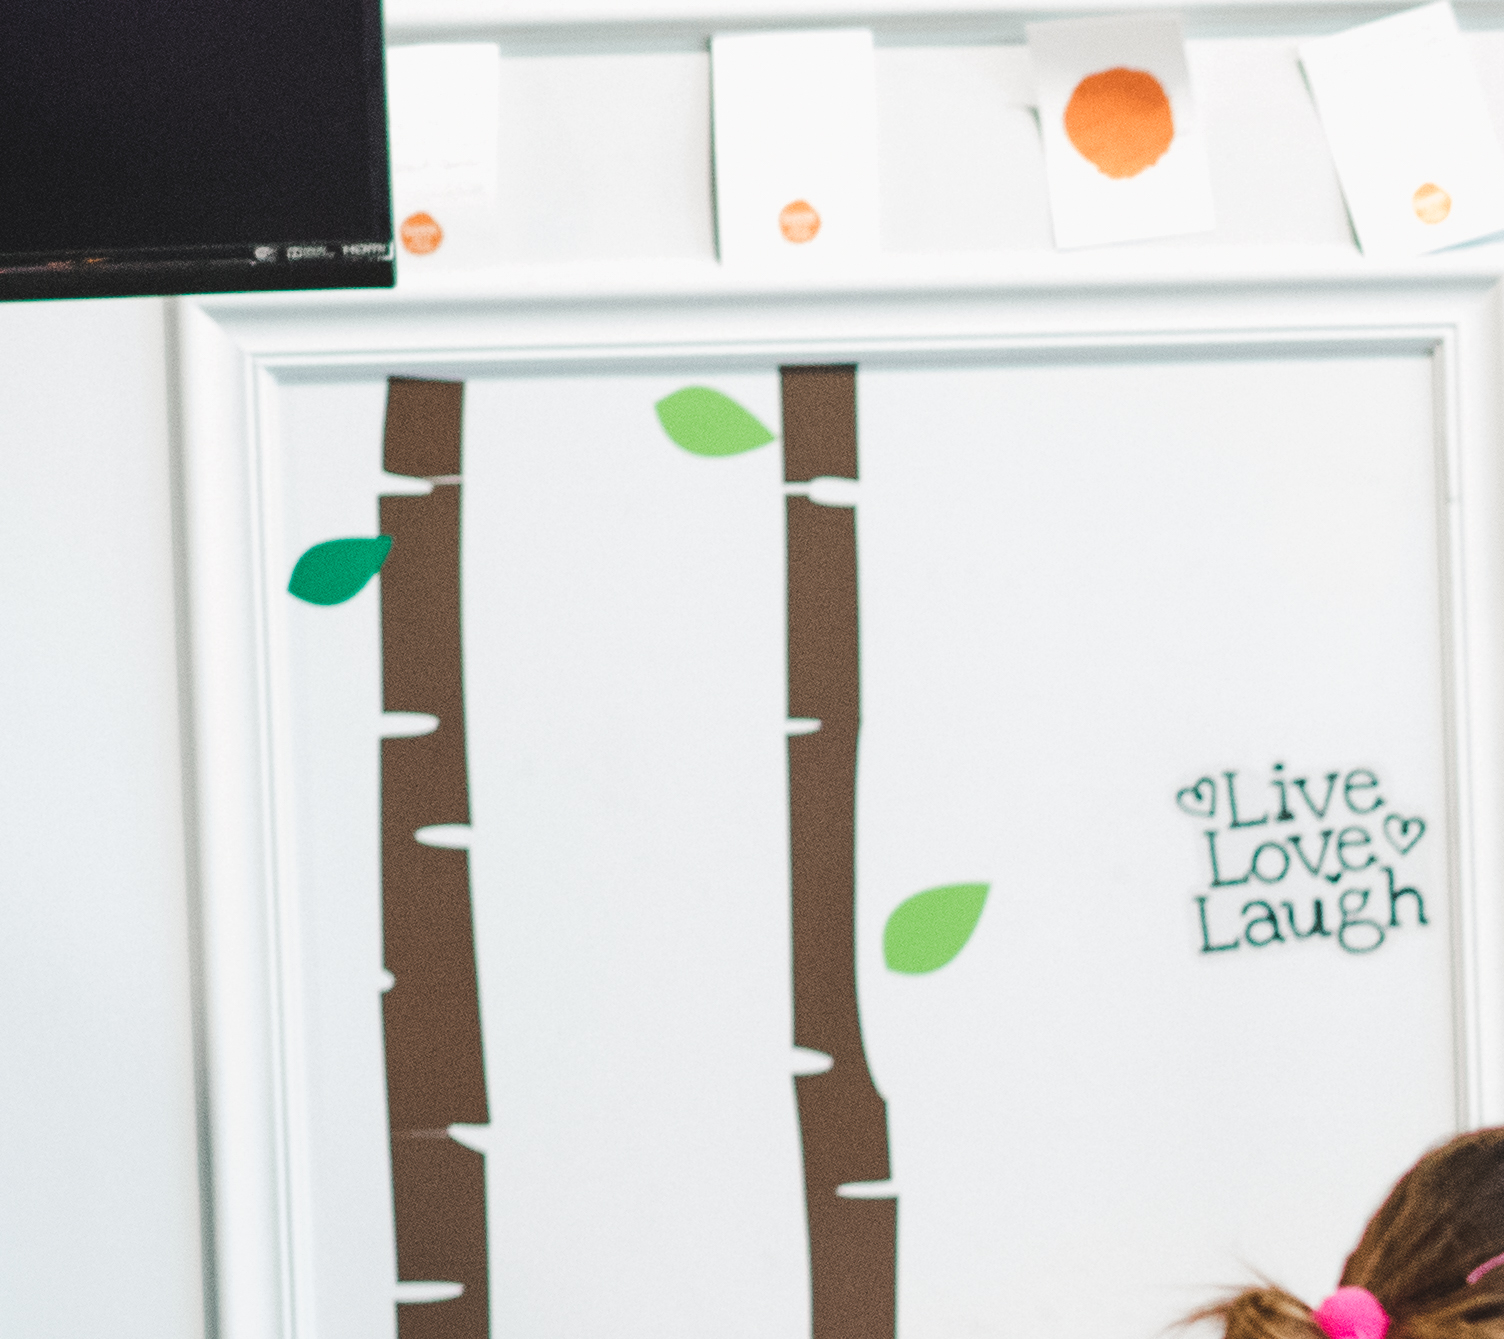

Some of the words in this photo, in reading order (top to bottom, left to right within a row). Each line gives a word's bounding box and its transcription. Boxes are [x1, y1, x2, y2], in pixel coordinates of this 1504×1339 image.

[1222, 761, 1385, 829] Live
[1204, 826, 1378, 888] Love
[1194, 866, 1430, 954] Laugh
